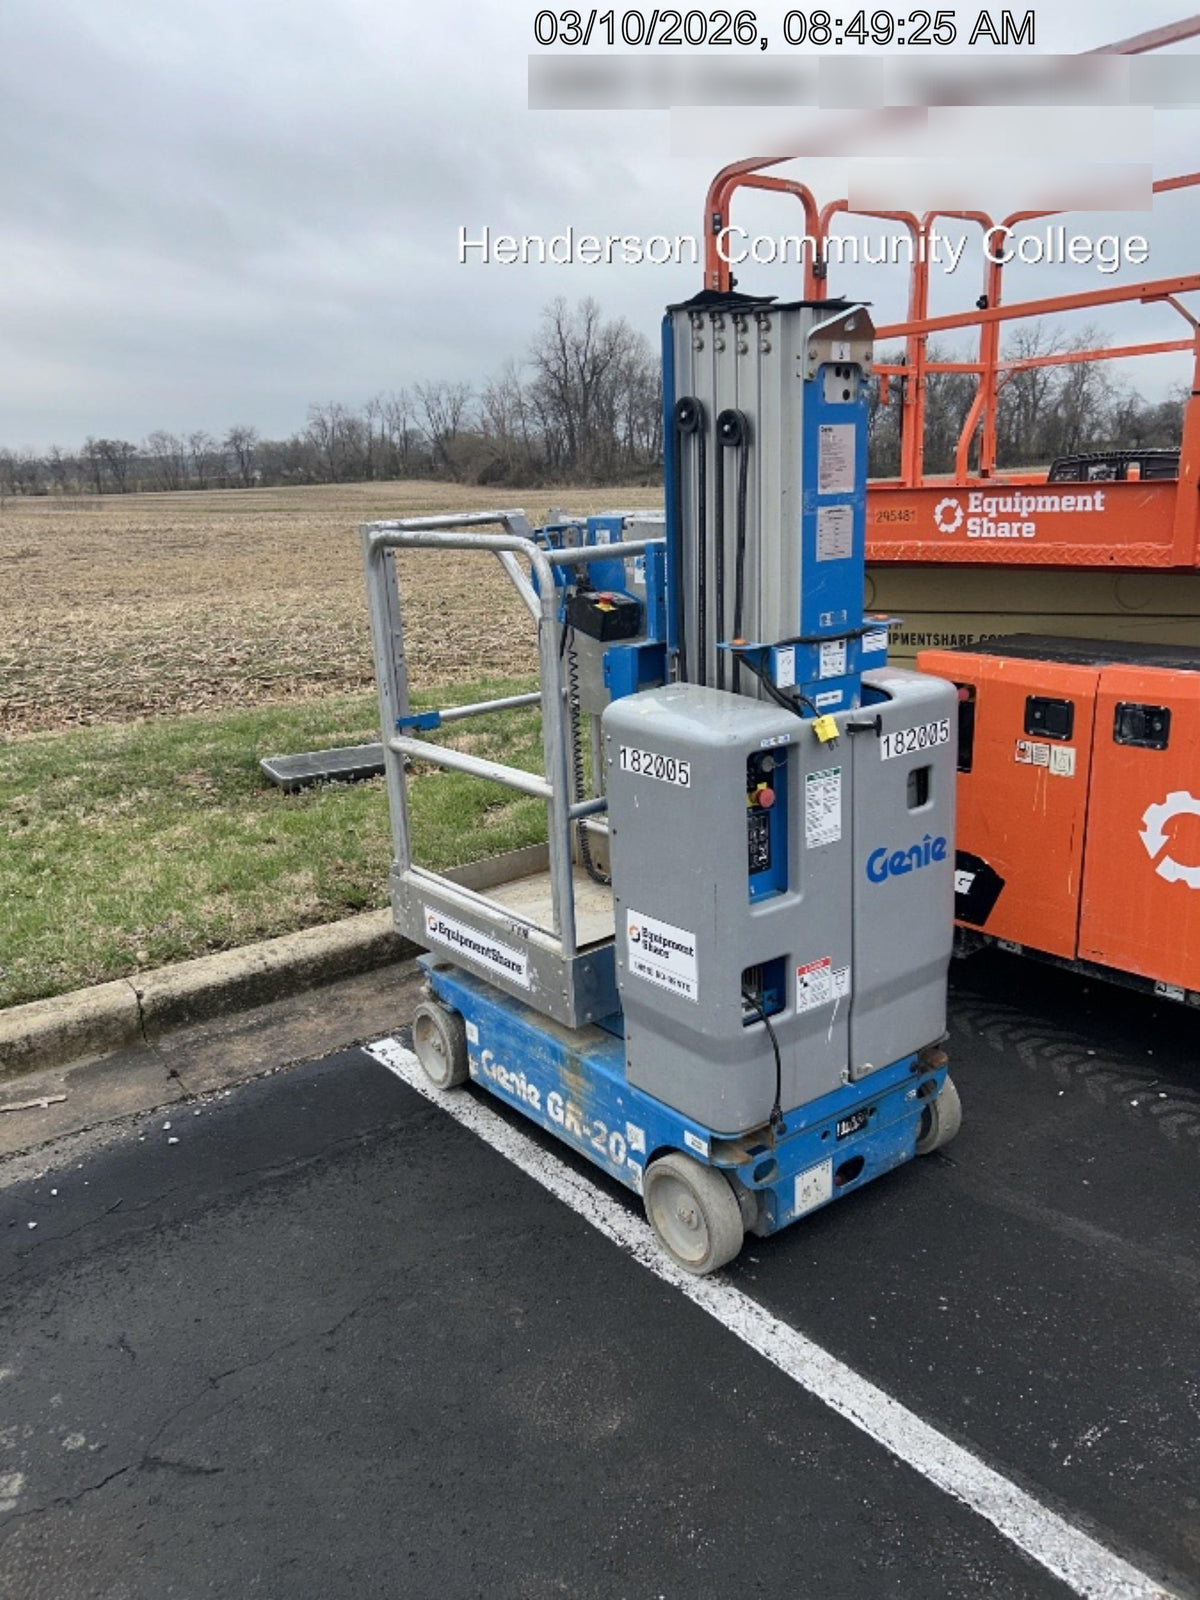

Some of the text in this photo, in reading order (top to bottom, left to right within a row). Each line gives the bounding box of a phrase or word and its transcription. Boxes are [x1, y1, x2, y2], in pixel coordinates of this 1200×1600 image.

[967, 490, 1106, 518] Equipment
[966, 517, 1036, 538] Share
[883, 719, 949, 758] 182005
[620, 748, 690, 785] 182005
[437, 922, 524, 975] EquipmentShare
[546, 1091, 627, 1165] GR-20
